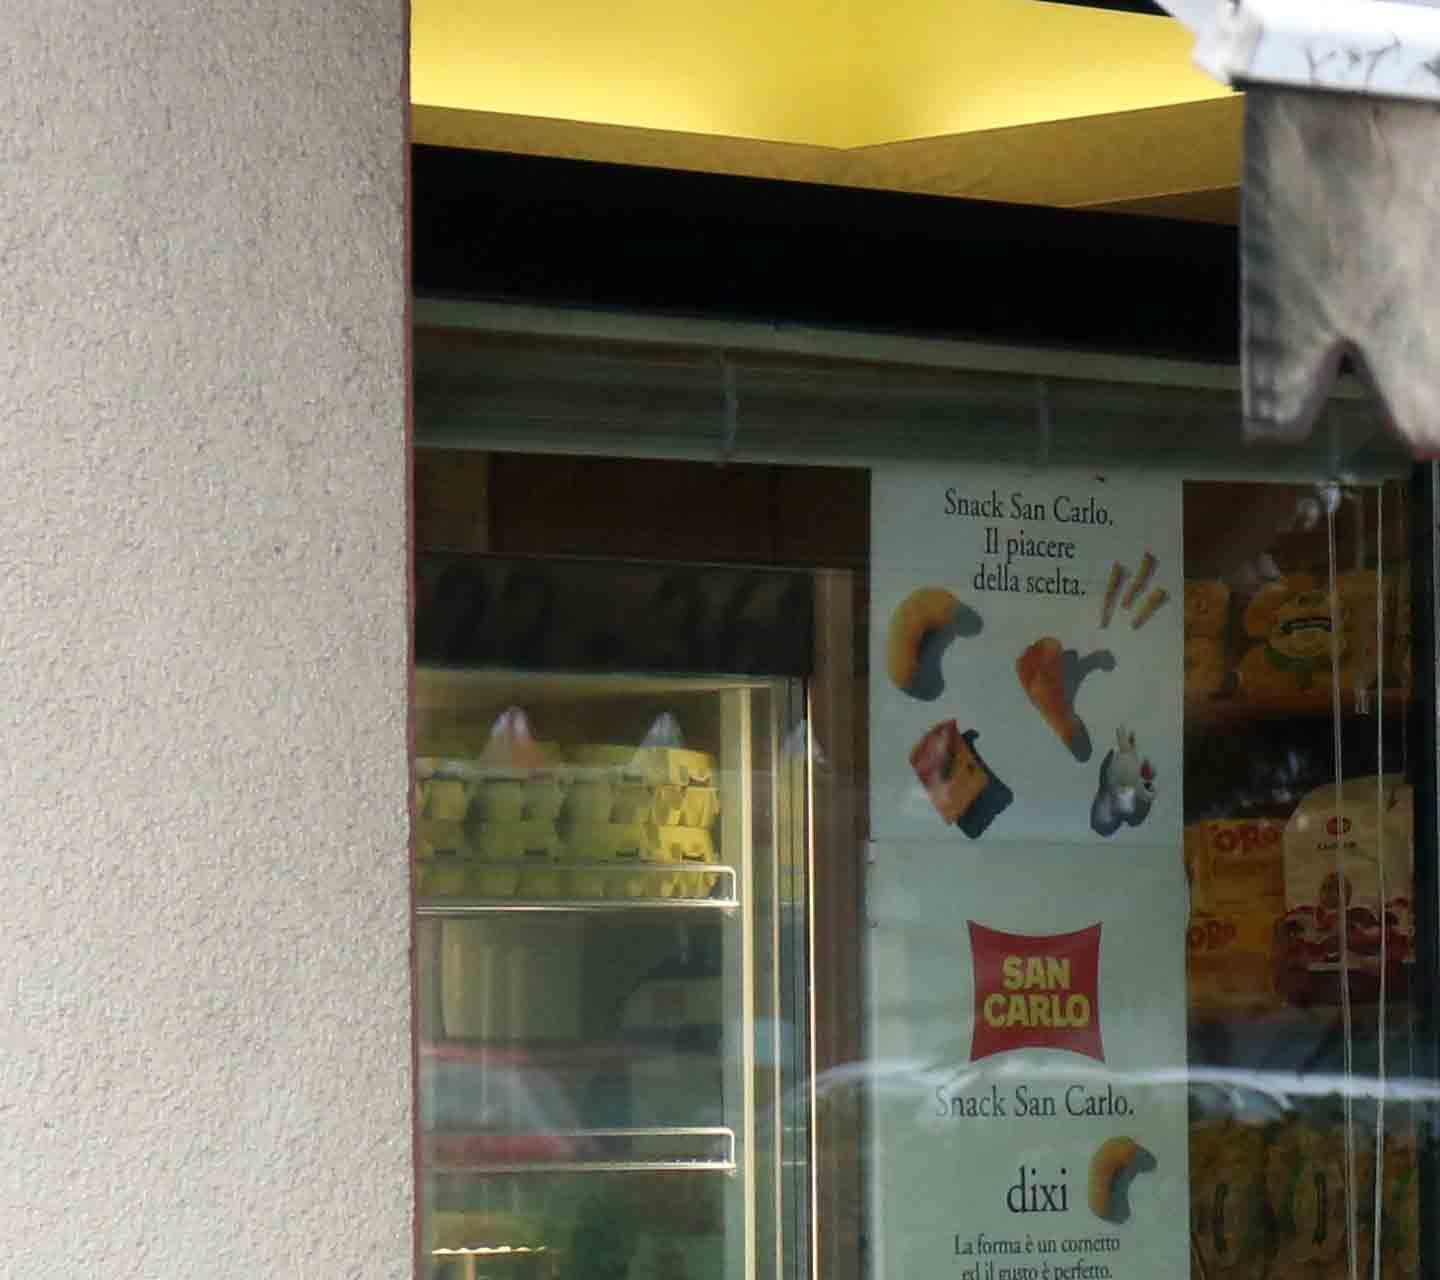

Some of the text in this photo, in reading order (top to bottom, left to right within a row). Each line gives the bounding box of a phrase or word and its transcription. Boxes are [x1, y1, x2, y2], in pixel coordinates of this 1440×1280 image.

[944, 488, 1004, 519] Snack
[1010, 493, 1045, 522] San
[1007, 531, 1075, 563] piacere
[973, 566, 1086, 596] della scelta.
[1002, 955, 1071, 990] SAN
[984, 993, 1090, 1027] CARLO
[935, 1084, 1134, 1117] Snack San Carlo.
[1006, 1165, 1069, 1213] dixi
[954, 1235, 973, 1255] La
[977, 1233, 1021, 1255] forma
[1038, 1238, 1057, 1253] un
[1062, 1235, 1120, 1253] cornetto
